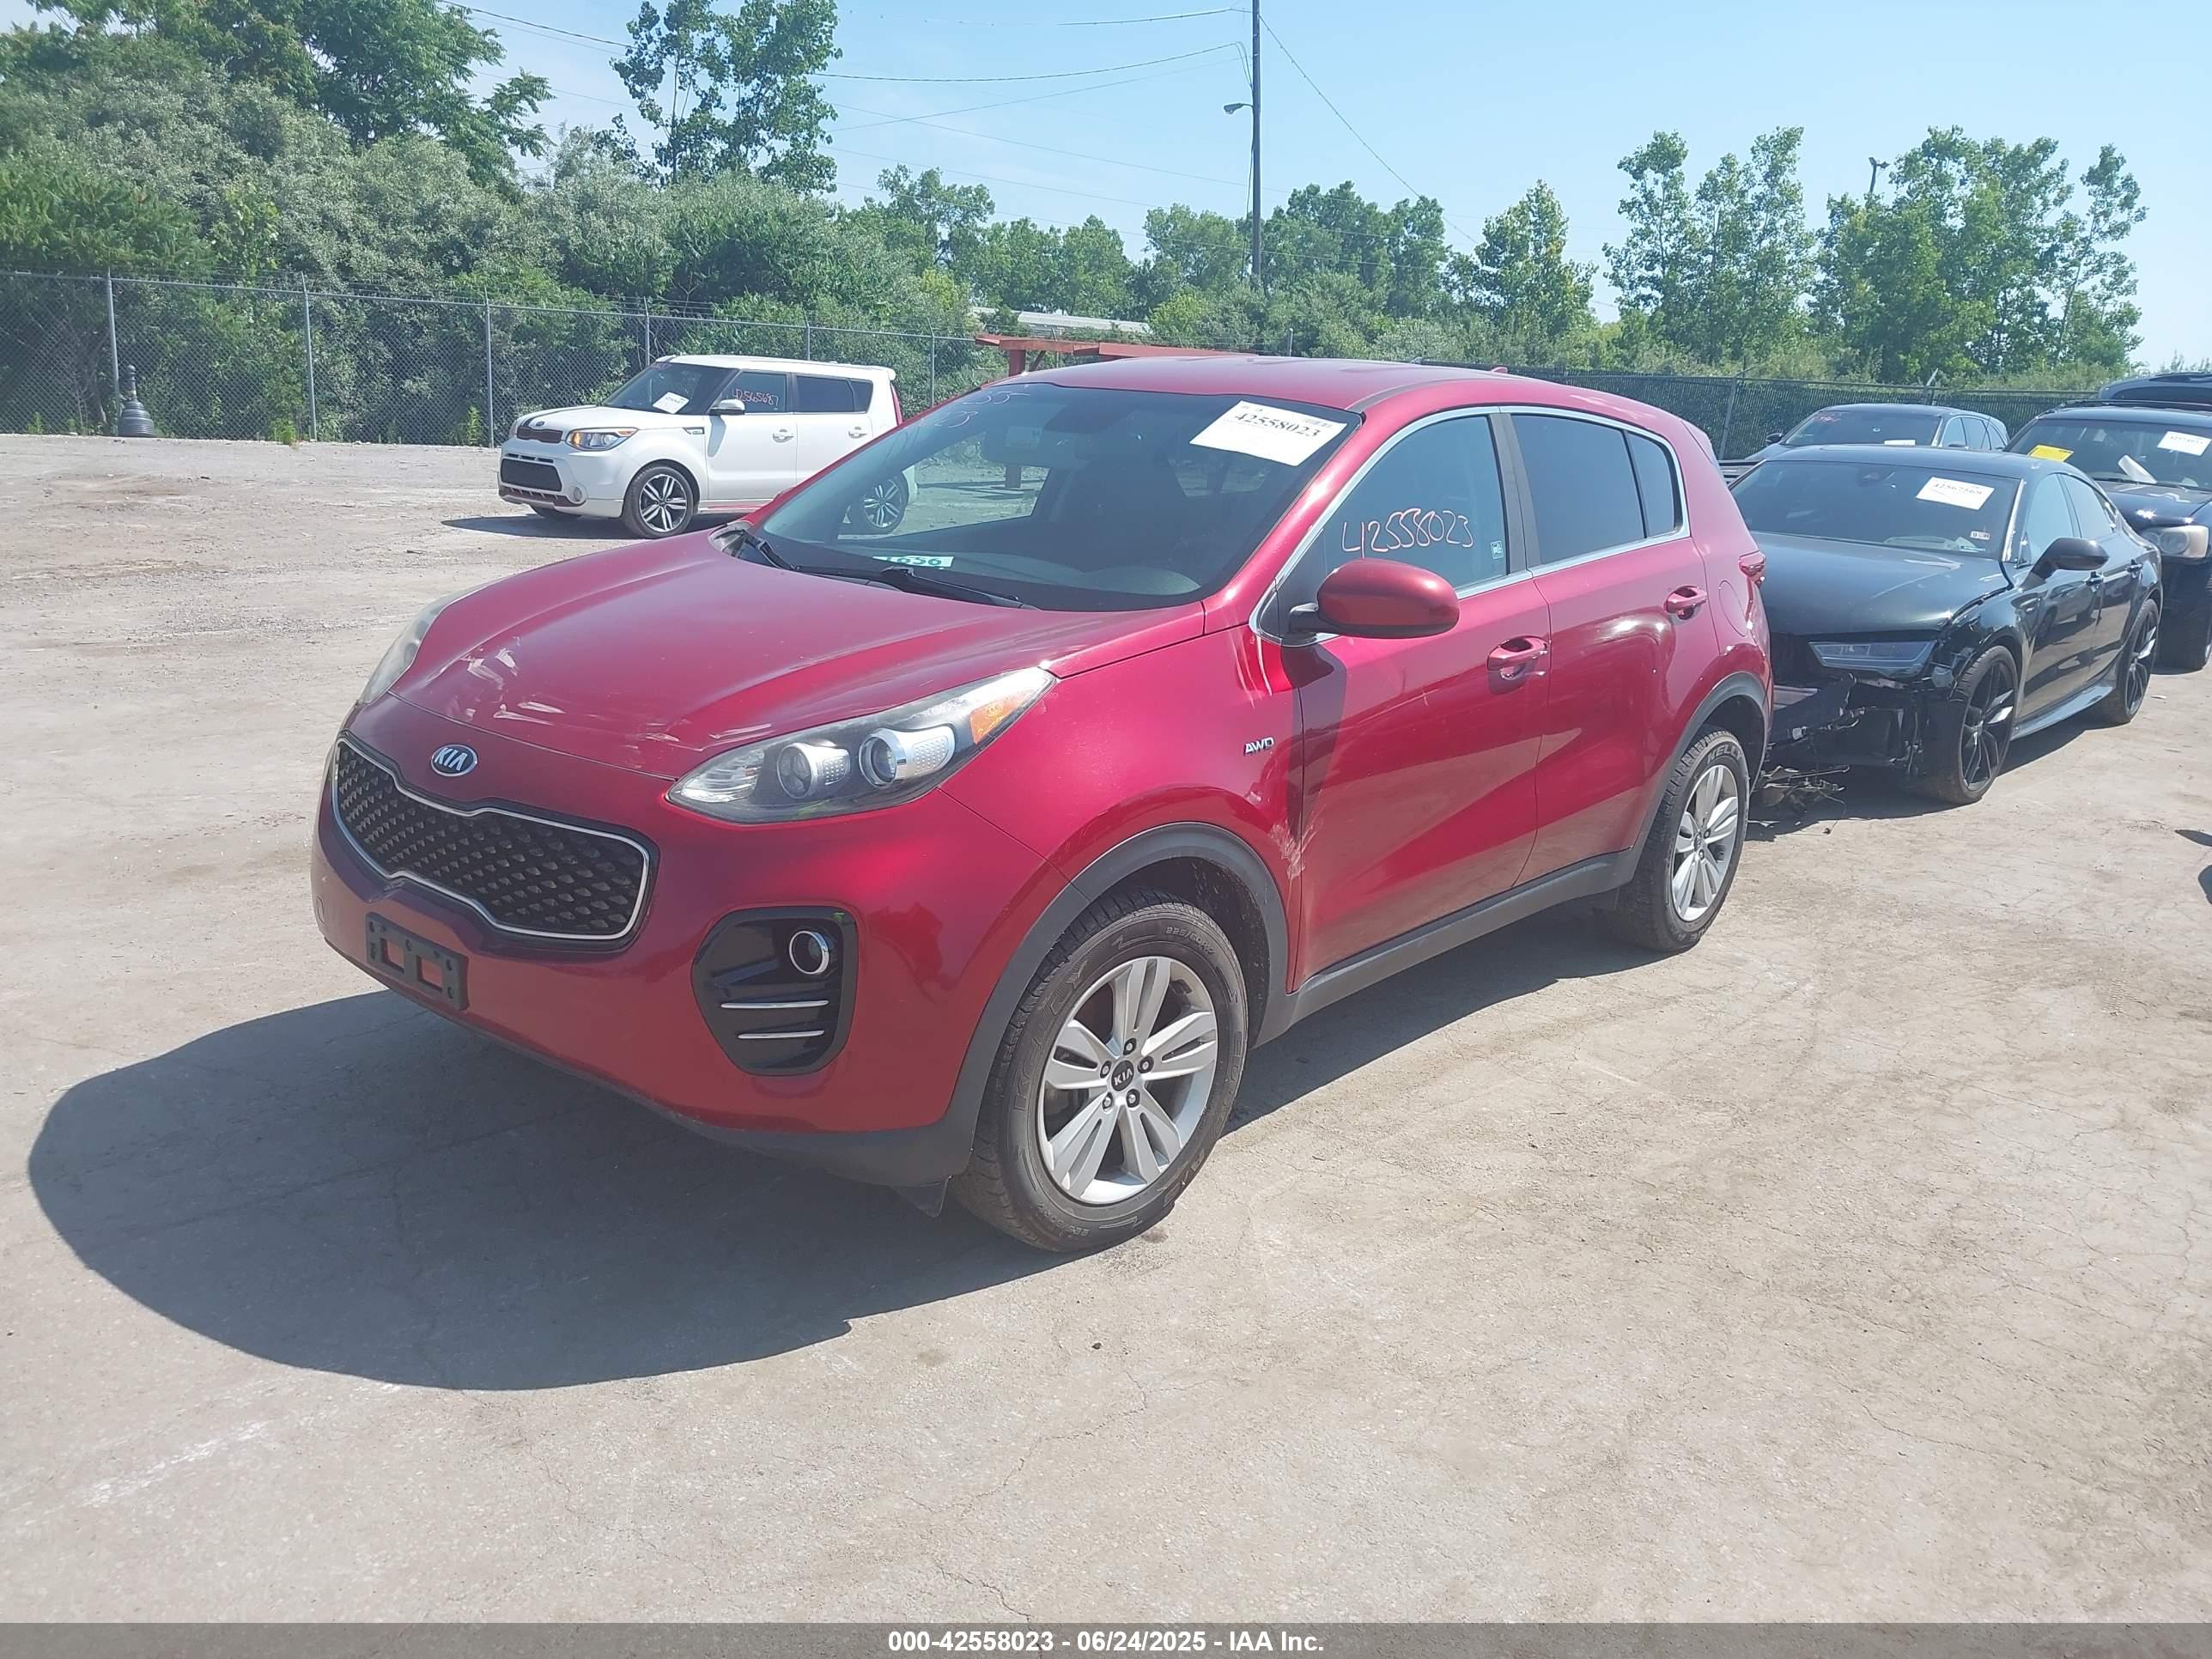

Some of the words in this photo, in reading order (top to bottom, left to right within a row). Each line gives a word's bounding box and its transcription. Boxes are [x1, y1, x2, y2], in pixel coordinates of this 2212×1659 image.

[1234, 412, 1321, 437] 42558023
[1341, 507, 1474, 558] 42558023
[1244, 737, 1274, 754] AWD
[1706, 744, 1743, 764] KELLY
[434, 747, 468, 771] KIA
[1114, 1068, 1133, 1086] KIA
